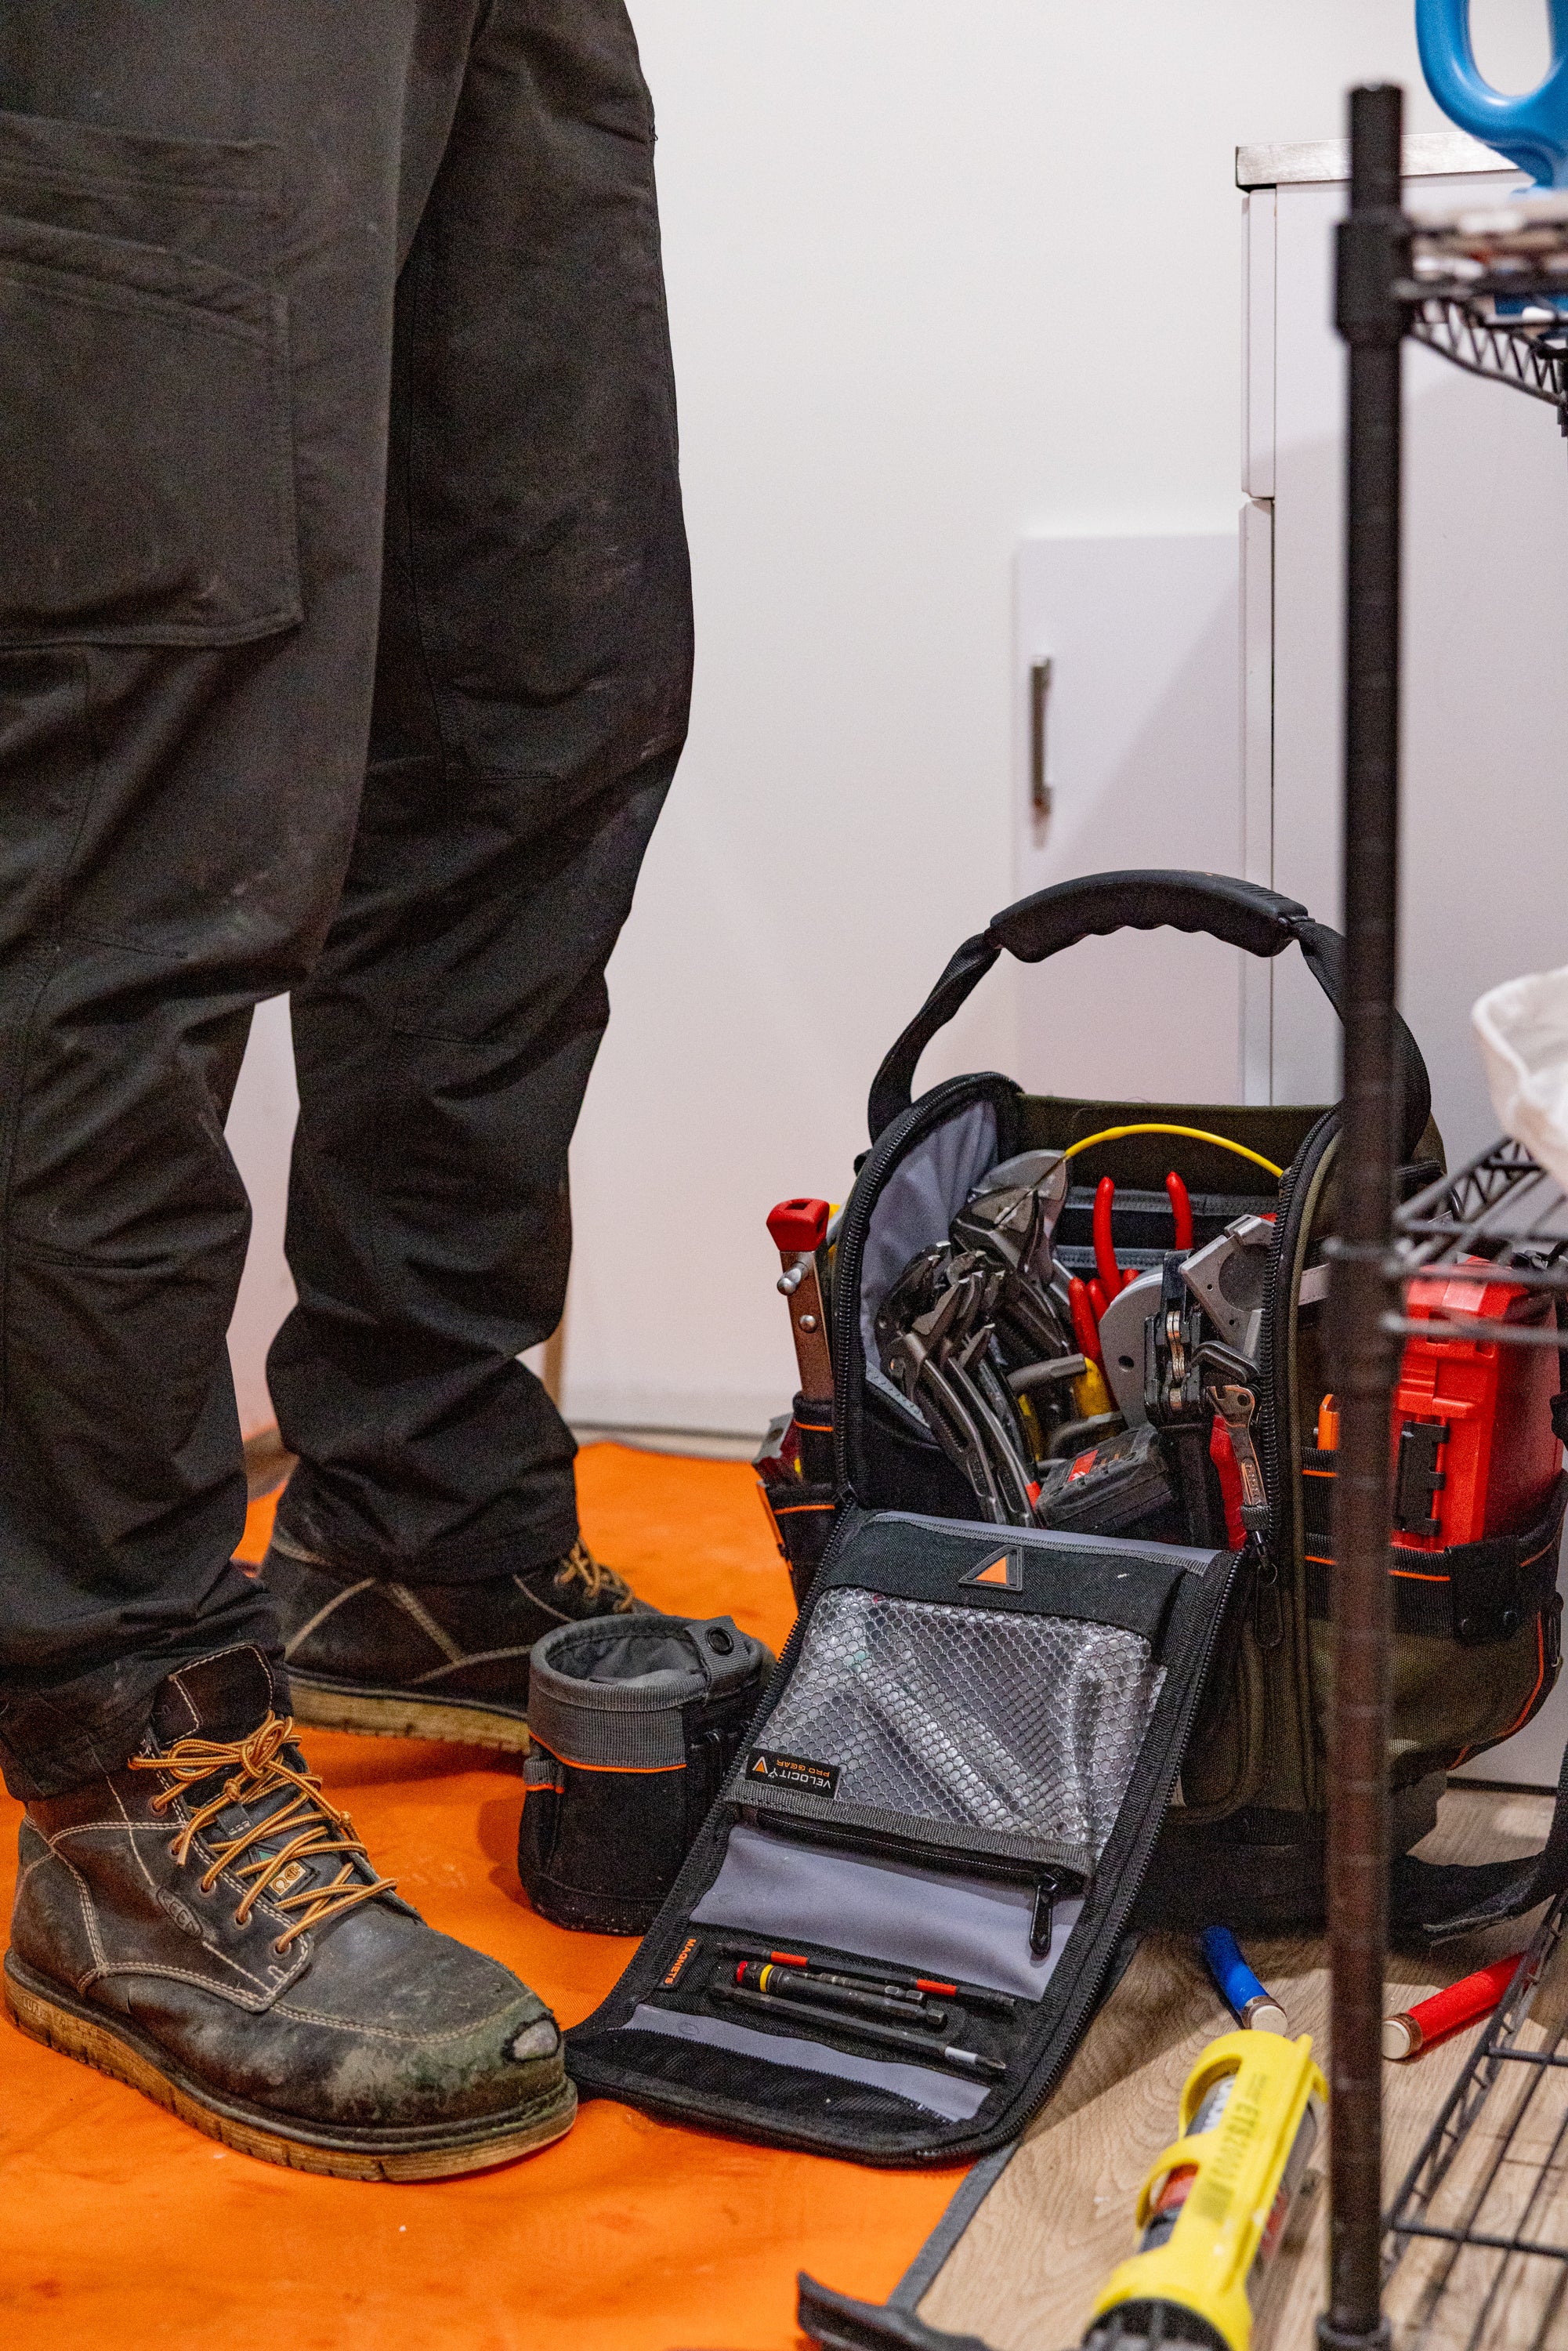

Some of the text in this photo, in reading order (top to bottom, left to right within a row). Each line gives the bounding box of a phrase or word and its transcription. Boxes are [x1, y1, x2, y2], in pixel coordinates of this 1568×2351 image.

[769, 1768, 831, 1789] VELOCITY
[777, 1759, 831, 1777] PRO GEAR
[664, 1938, 697, 1985] MAGNETS
